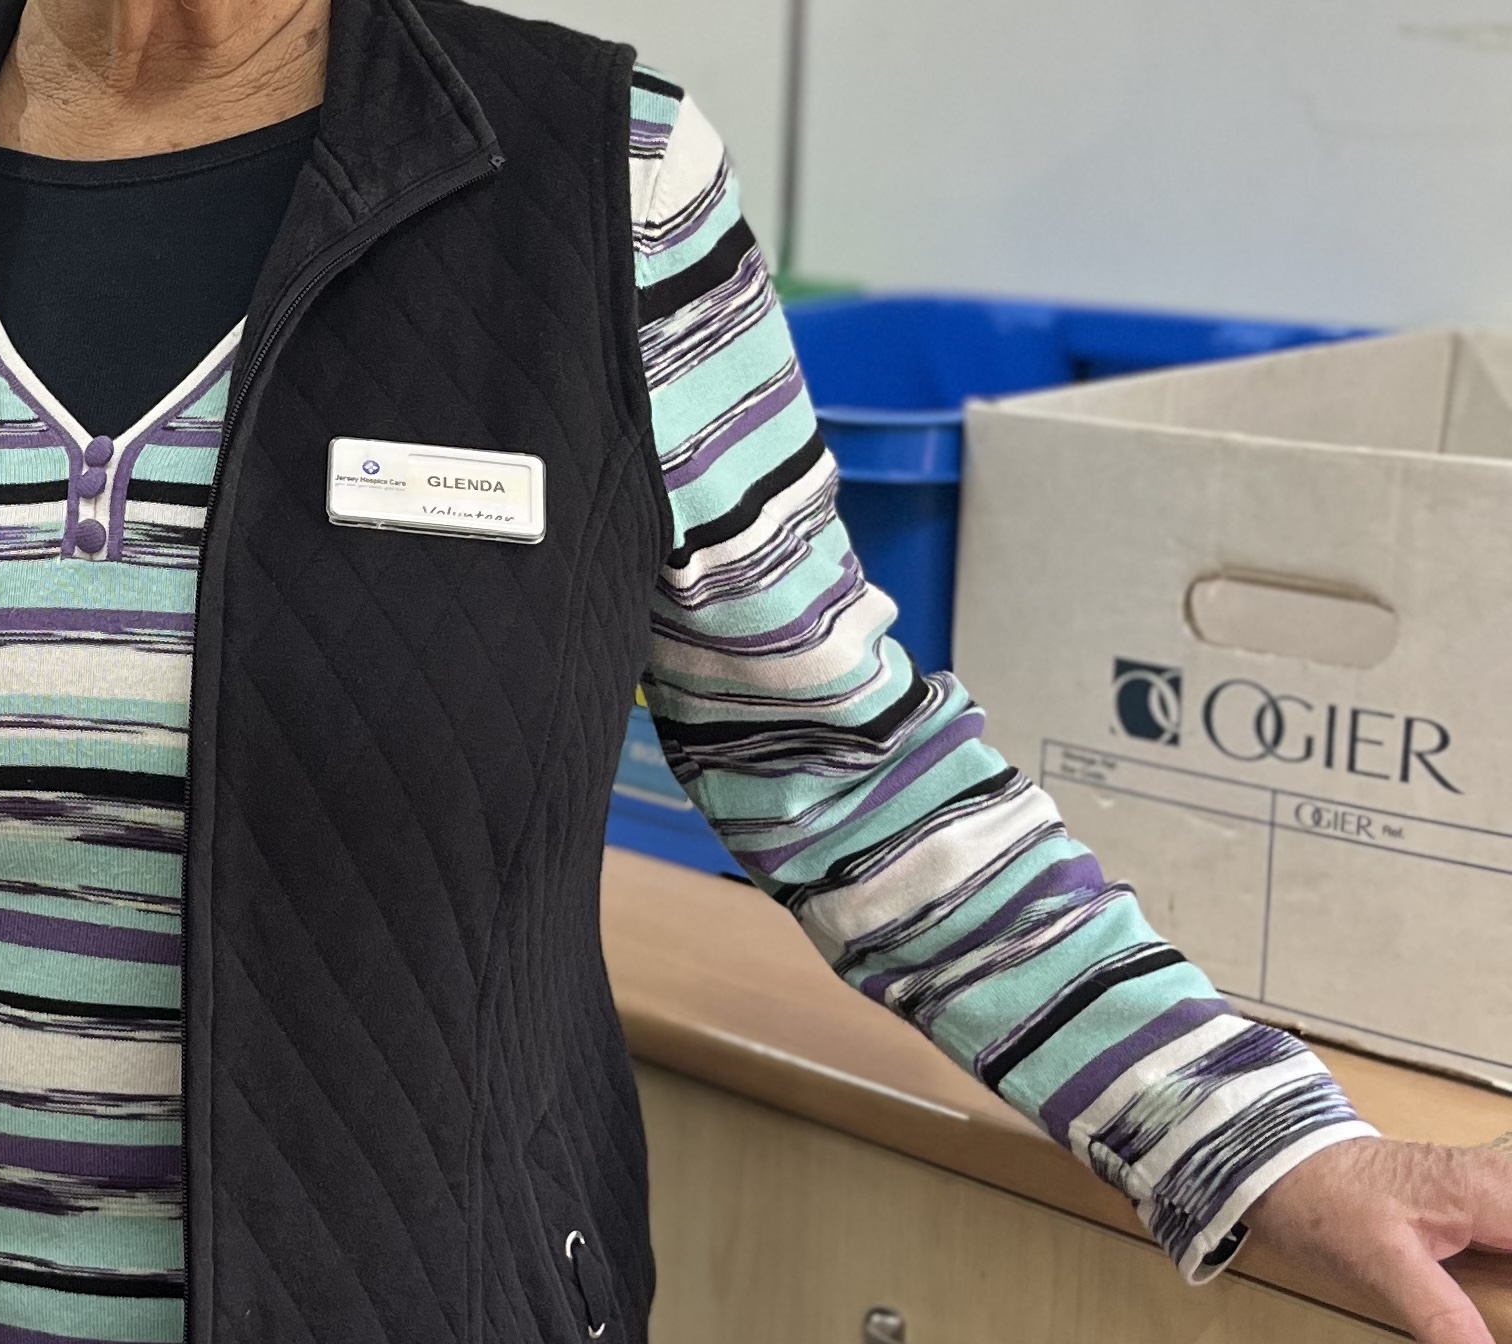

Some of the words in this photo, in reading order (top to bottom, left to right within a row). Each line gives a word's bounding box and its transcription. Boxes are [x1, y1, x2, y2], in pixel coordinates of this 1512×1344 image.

[335, 474, 359, 483] Jersey
[427, 475, 506, 493] GLENDA
[1201, 677, 1466, 796] OGIER
[1294, 801, 1376, 841] OGIER
